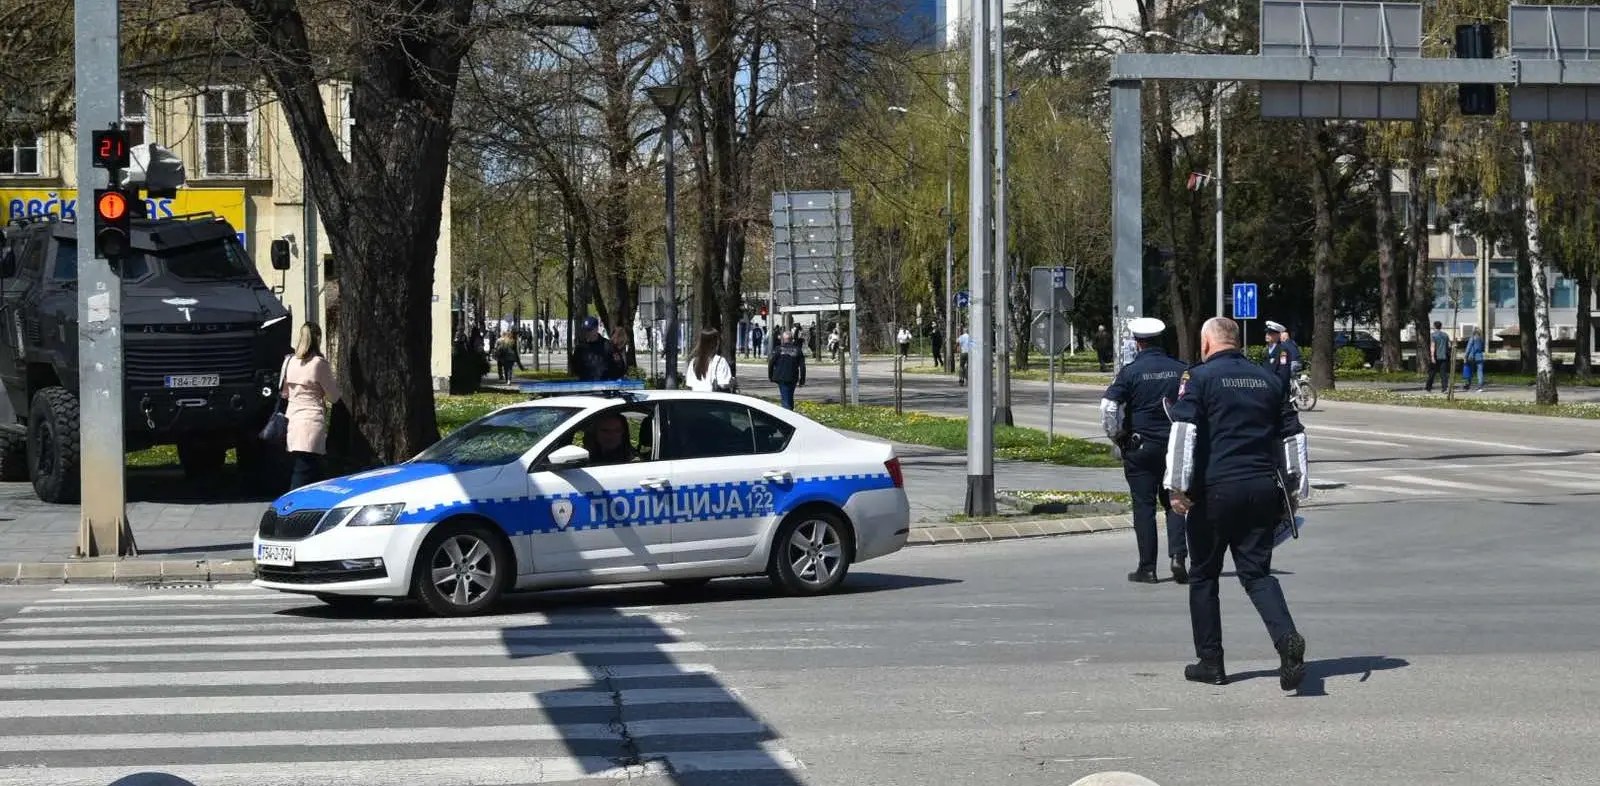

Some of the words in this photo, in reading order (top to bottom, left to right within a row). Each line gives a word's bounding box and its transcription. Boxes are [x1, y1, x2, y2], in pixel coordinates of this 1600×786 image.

[101, 140, 121, 156] 21
[144, 199, 173, 220] AS
[590, 489, 744, 522] ПОЛИЦИЈА
[745, 491, 774, 510] 122
